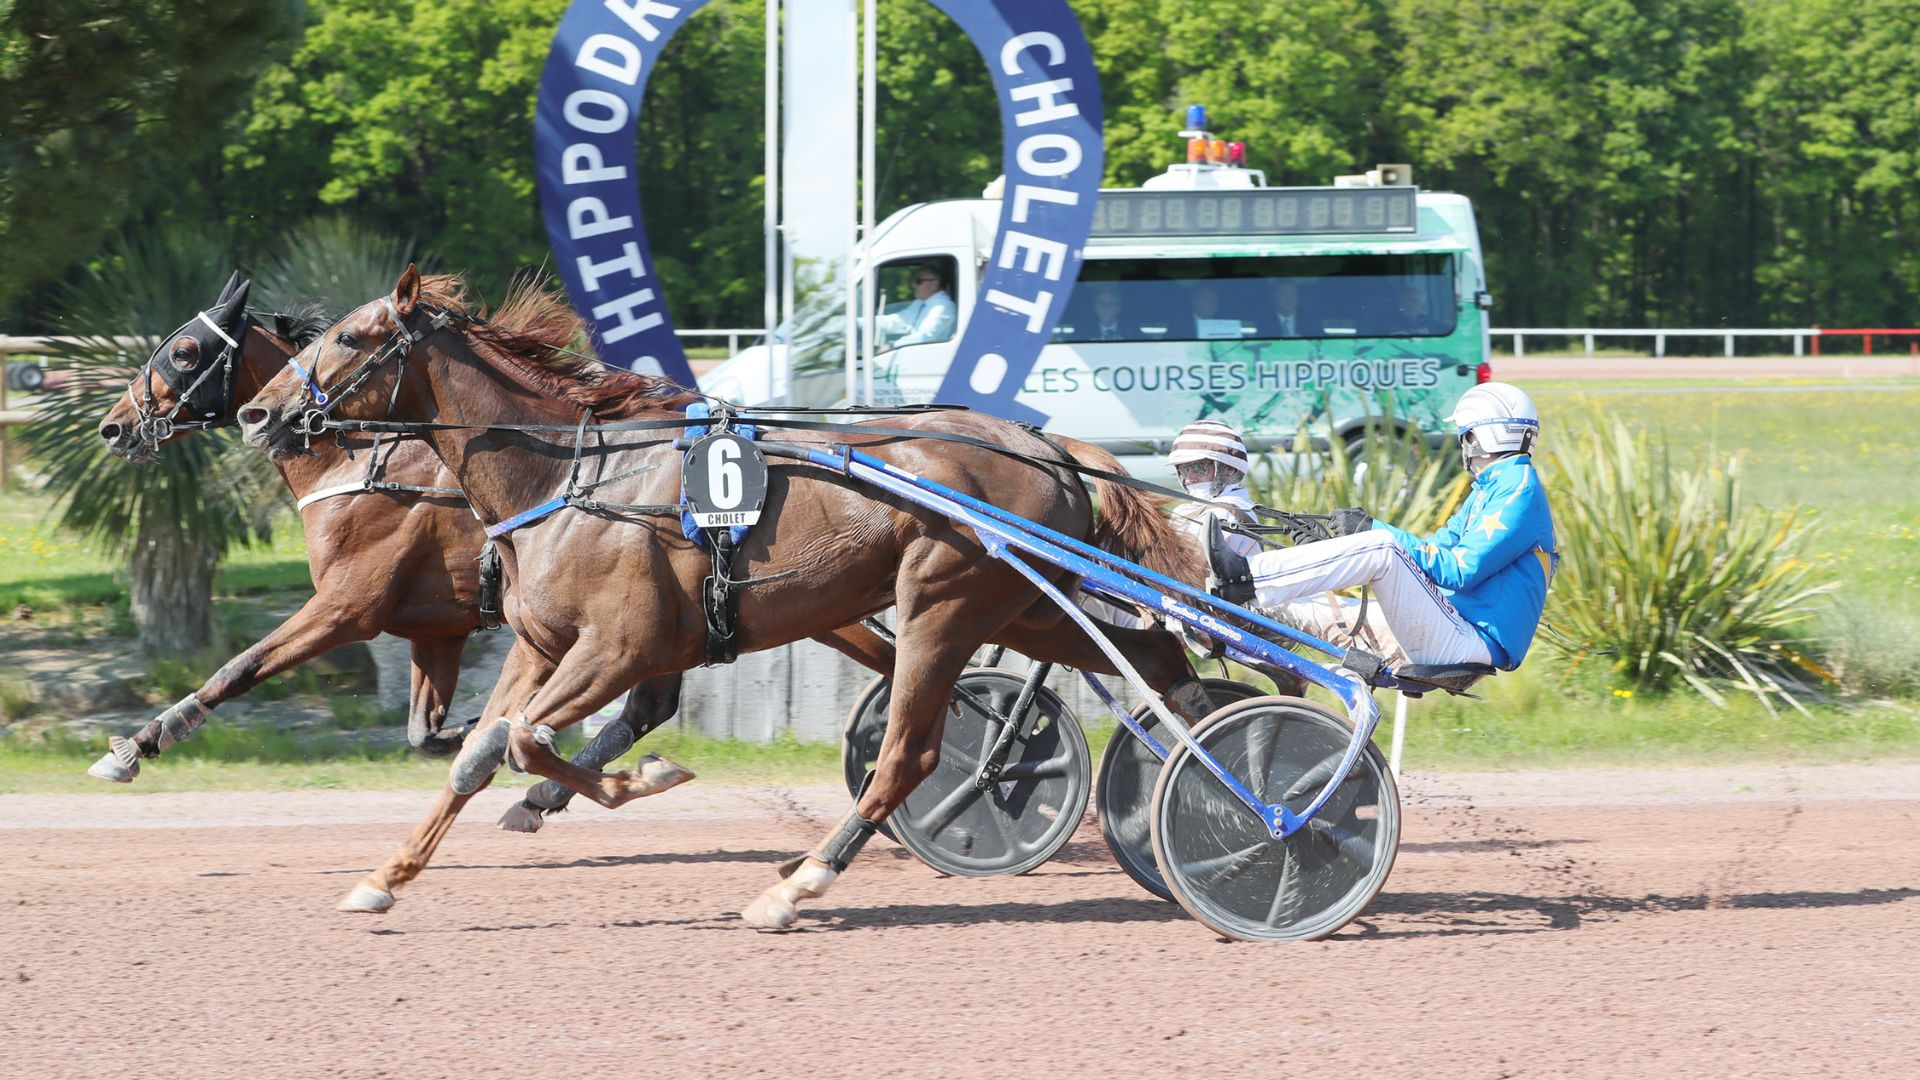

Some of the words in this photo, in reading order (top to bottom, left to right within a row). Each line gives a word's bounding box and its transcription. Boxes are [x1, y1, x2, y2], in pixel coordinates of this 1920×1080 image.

[985, 31, 1083, 335] CHOLET
[1022, 368, 1079, 393] LES
[1093, 364, 1247, 392] COURSES
[1258, 360, 1440, 391] HIPPIQUES
[707, 438, 743, 510] 6
[708, 513, 745, 525] CHOLET
[1198, 615, 1243, 641] Chrono
